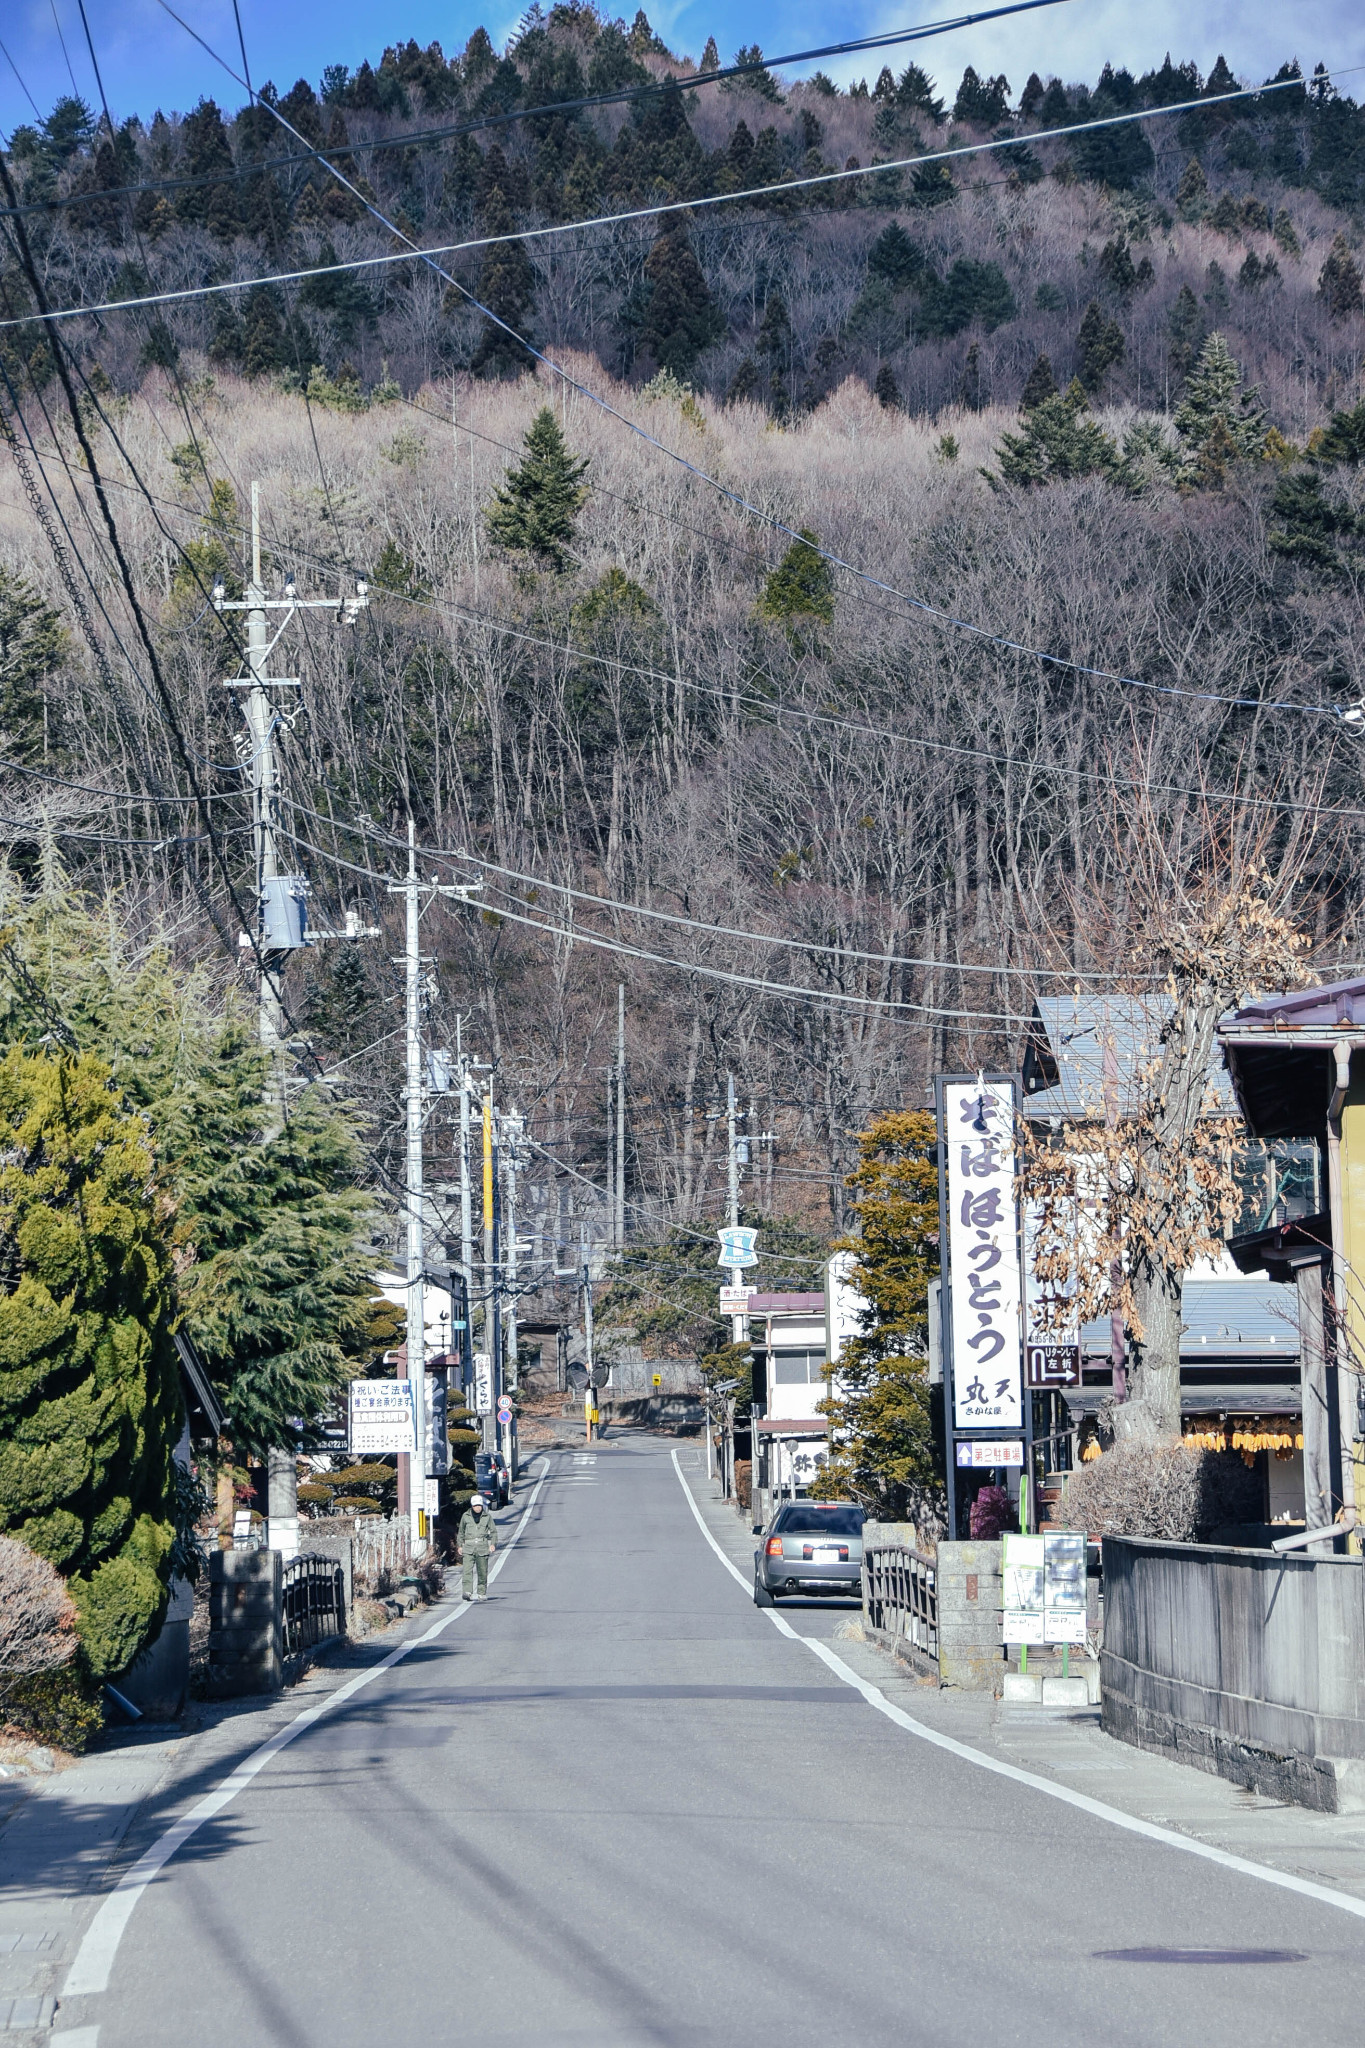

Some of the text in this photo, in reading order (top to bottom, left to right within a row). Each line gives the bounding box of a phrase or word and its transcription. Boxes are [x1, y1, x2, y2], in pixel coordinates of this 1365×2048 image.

[1045, 1347, 1076, 1357] Uターンして
[1048, 1358, 1072, 1369] 左折
